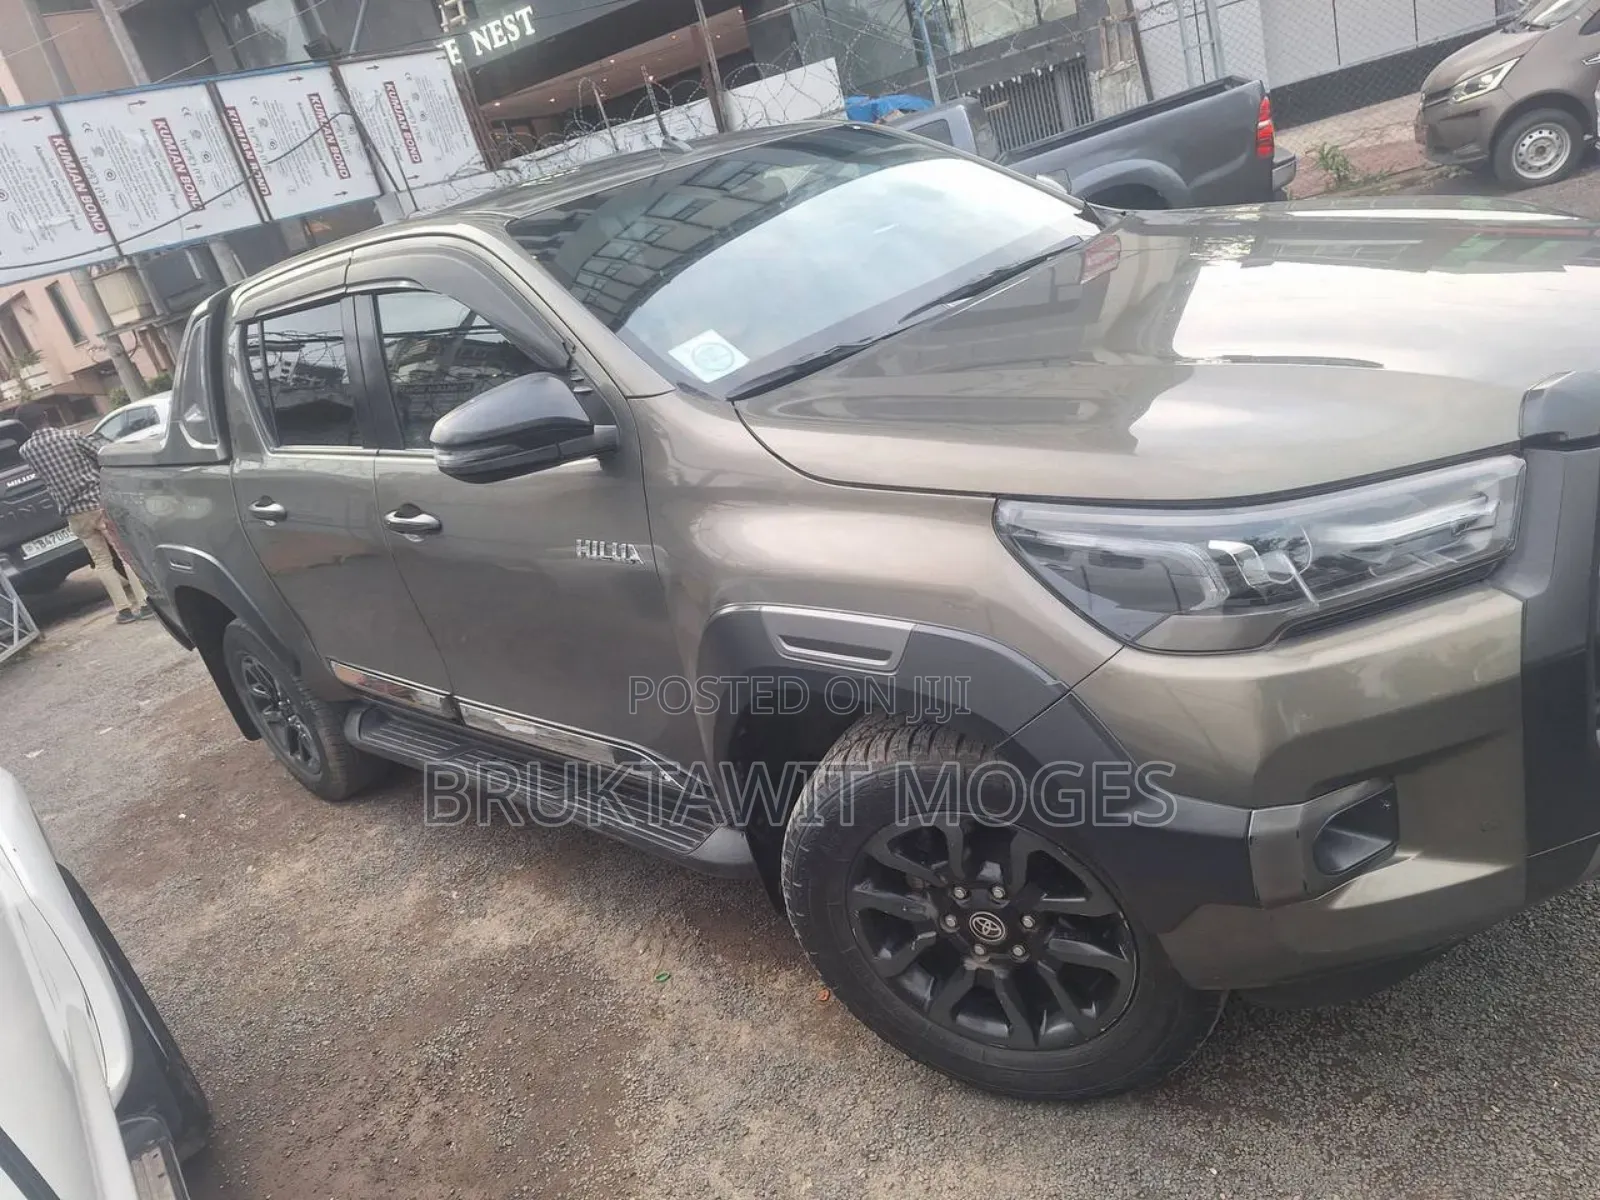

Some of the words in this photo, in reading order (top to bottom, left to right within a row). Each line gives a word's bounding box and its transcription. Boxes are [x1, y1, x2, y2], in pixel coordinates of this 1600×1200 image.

[436, 38, 462, 66] E
[469, 5, 536, 56] NEST
[154, 118, 189, 177] KUMJAN
[385, 82, 408, 134] KUMJAN
[403, 132, 422, 163] BOND
[52, 135, 88, 194] KUMJAN
[80, 193, 107, 232] BOND
[331, 146, 349, 179] BOND
